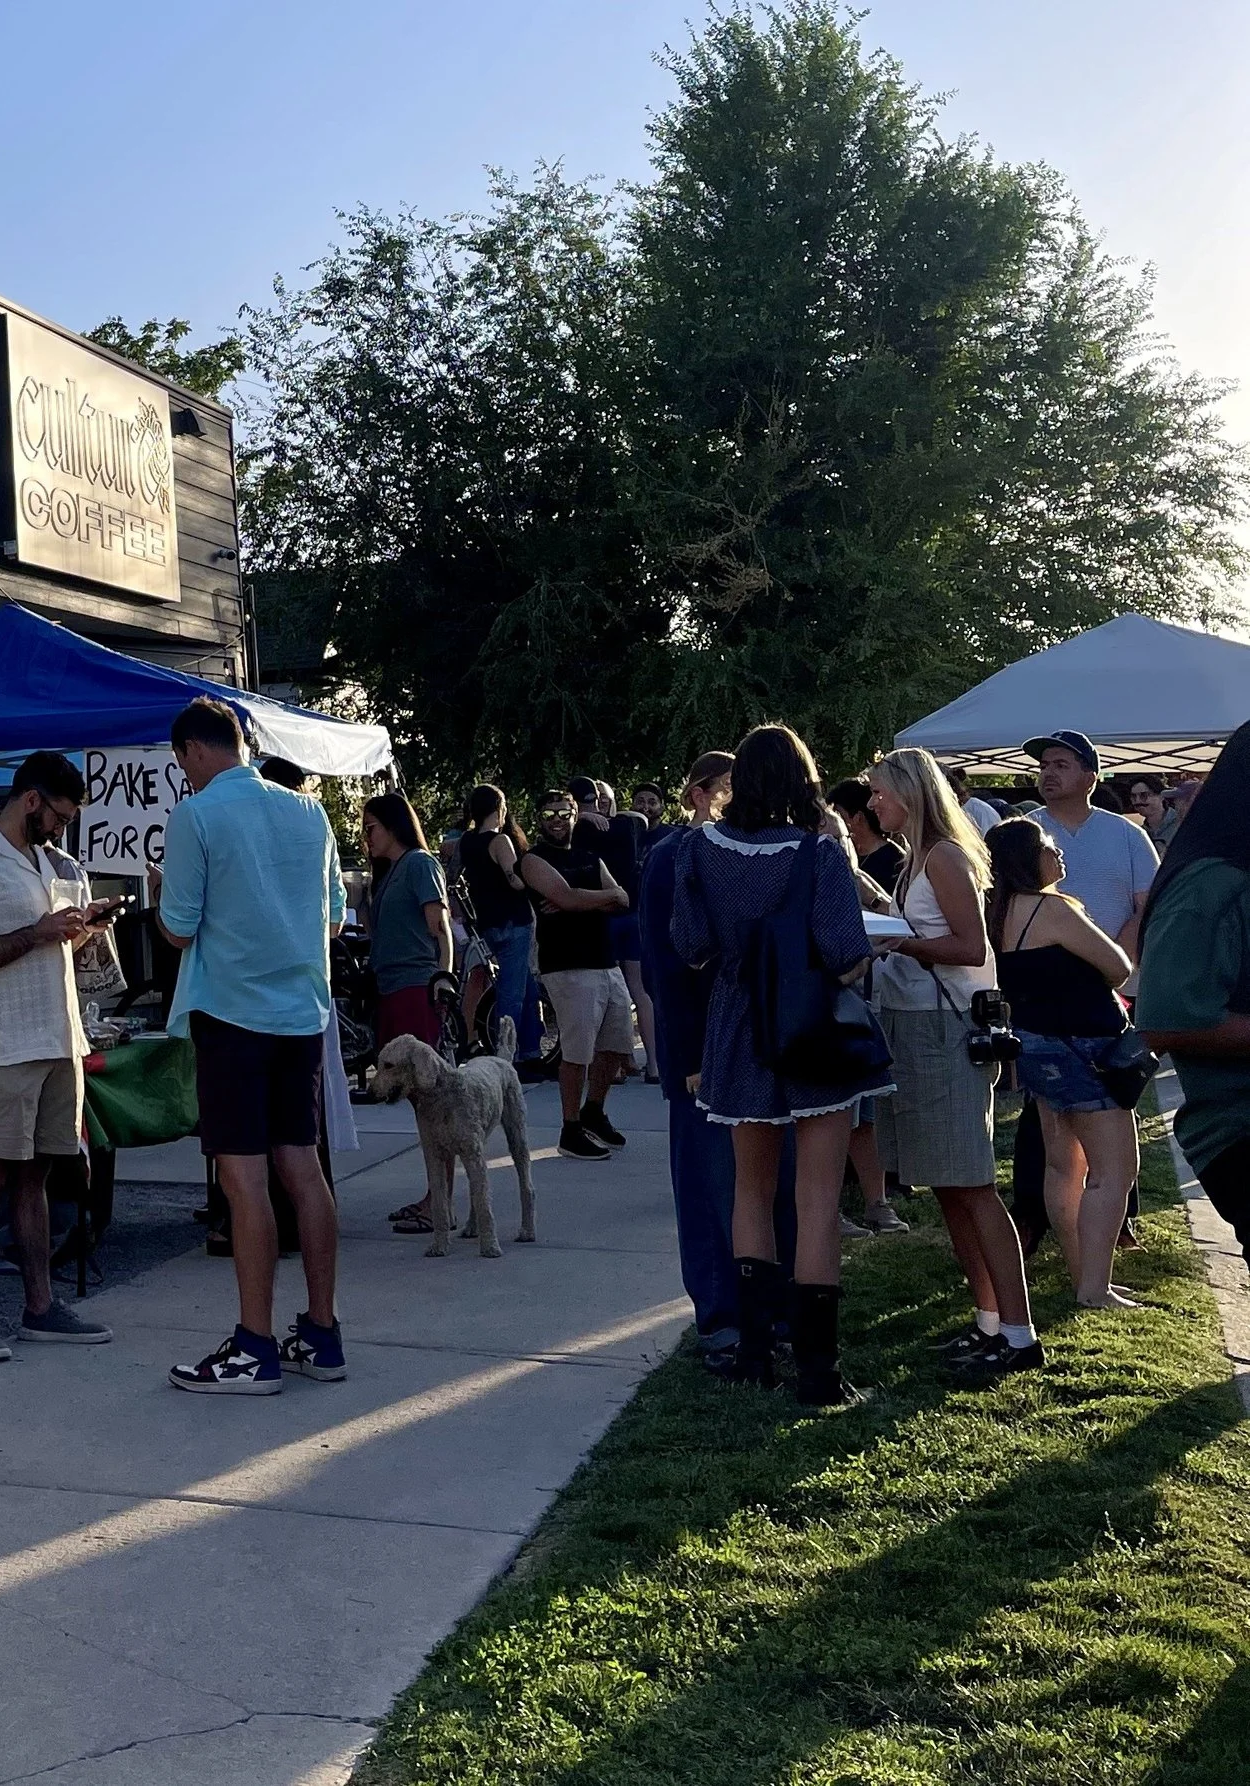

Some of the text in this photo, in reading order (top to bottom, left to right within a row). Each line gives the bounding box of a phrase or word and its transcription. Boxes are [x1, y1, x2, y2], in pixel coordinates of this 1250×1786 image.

[19, 476, 167, 568] COFFEE
[86, 750, 194, 815] BAKE SA
[87, 820, 139, 863] FOR
